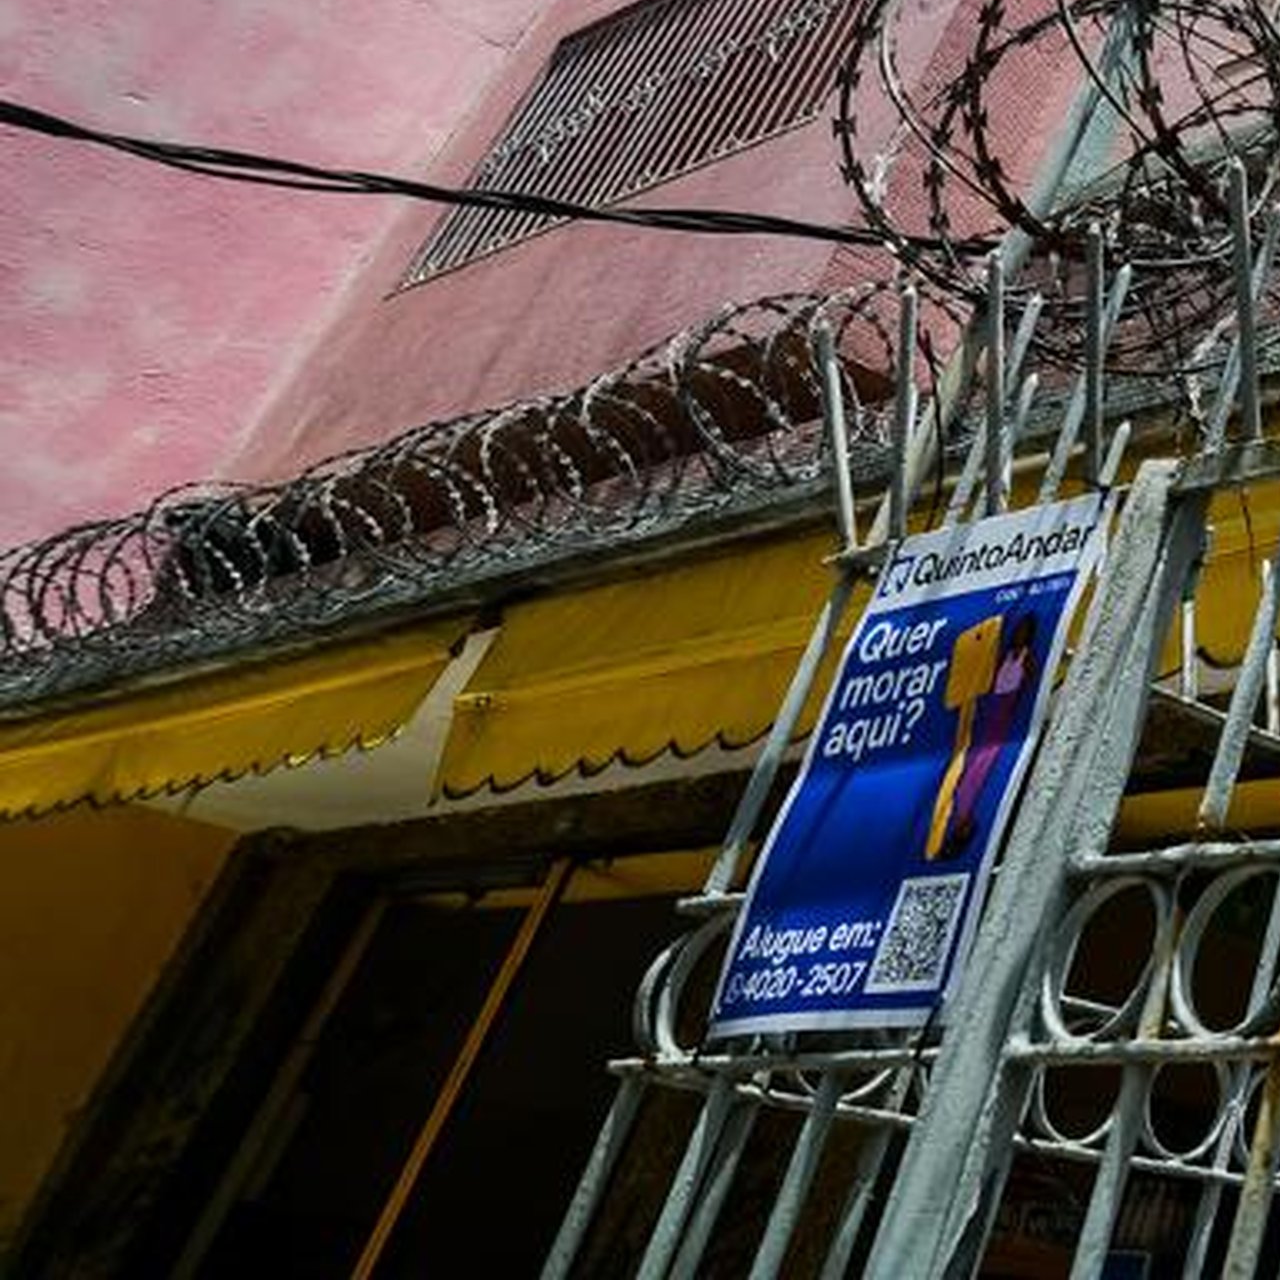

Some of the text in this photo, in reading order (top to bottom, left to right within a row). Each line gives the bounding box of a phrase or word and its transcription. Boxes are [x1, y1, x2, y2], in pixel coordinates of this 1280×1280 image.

[913, 523, 1098, 586] QuintoAndar
[859, 618, 948, 663] Quer
[839, 660, 948, 711] morar
[823, 698, 925, 762] aqui?
[737, 921, 881, 964] Alugue em:
[744, 961, 867, 1001] 4020-2507
